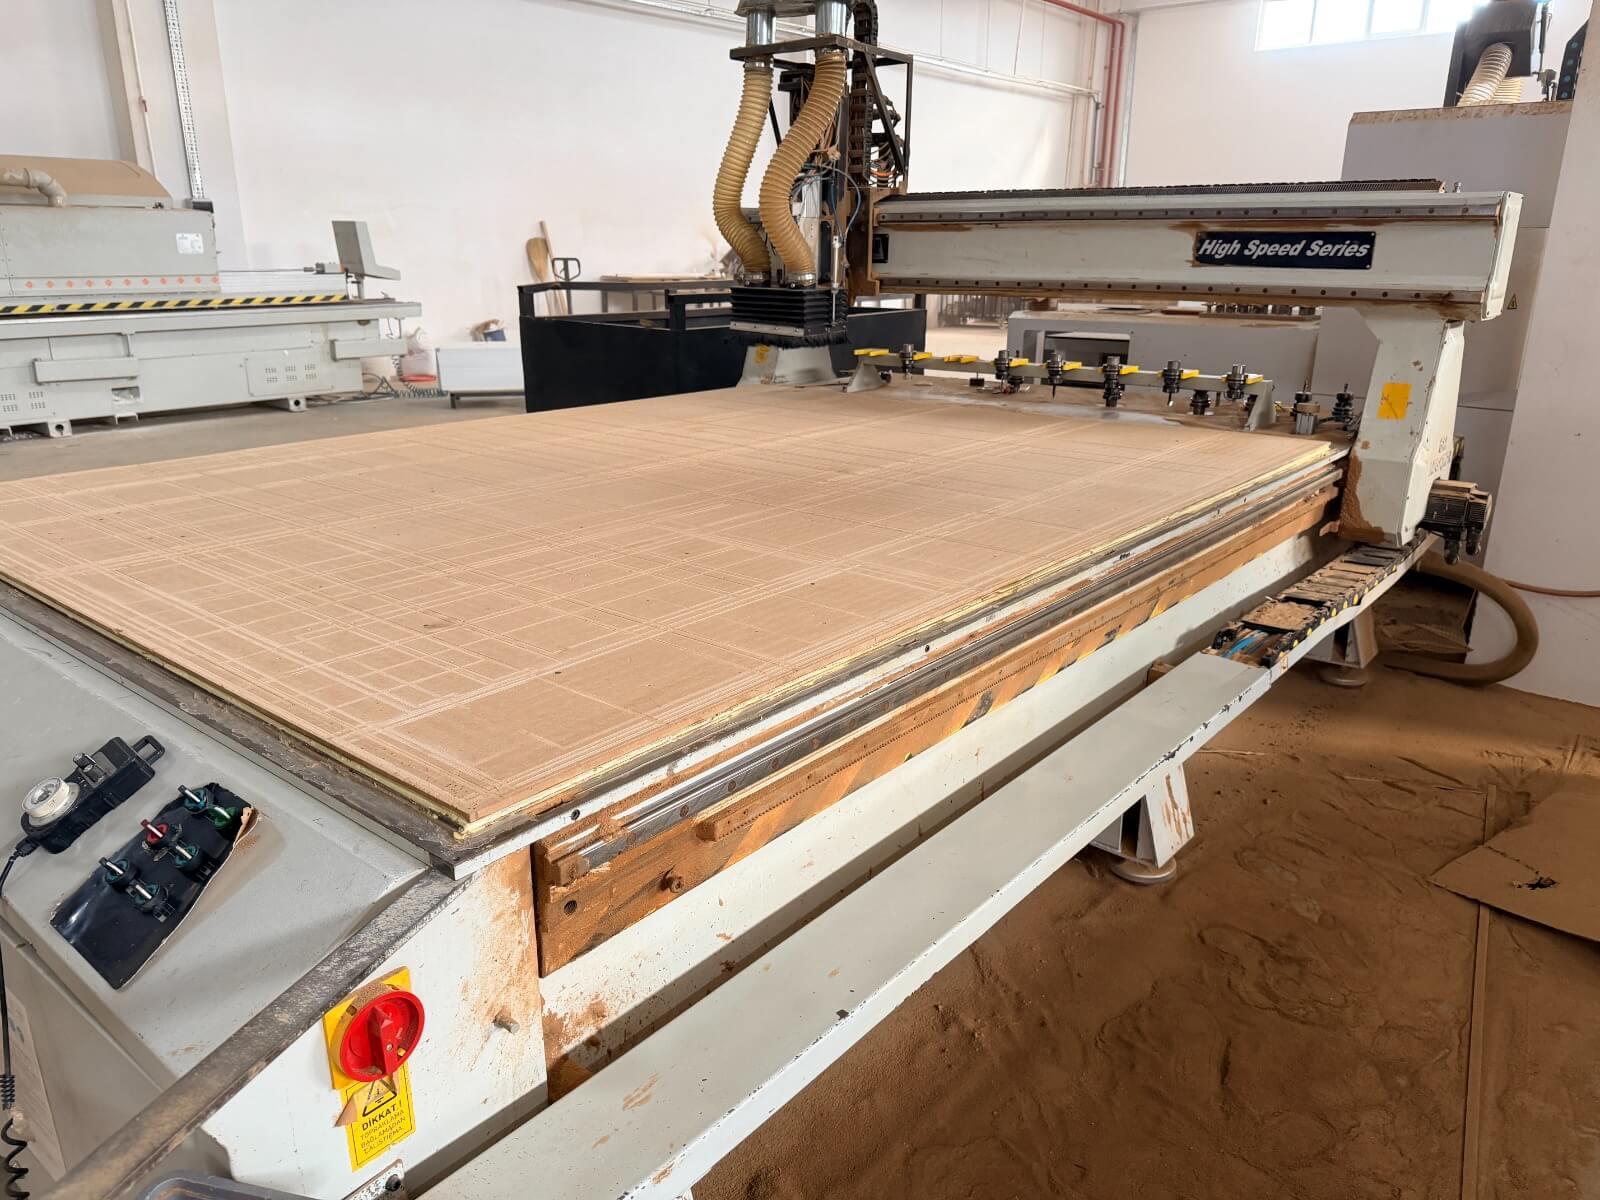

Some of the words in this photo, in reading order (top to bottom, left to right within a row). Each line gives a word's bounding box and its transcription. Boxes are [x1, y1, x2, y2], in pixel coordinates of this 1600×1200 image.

[1198, 240, 1241, 259] High
[1244, 239, 1307, 259] Speed
[1306, 240, 1370, 257] Series
[362, 1104, 396, 1131] DİKKAT
